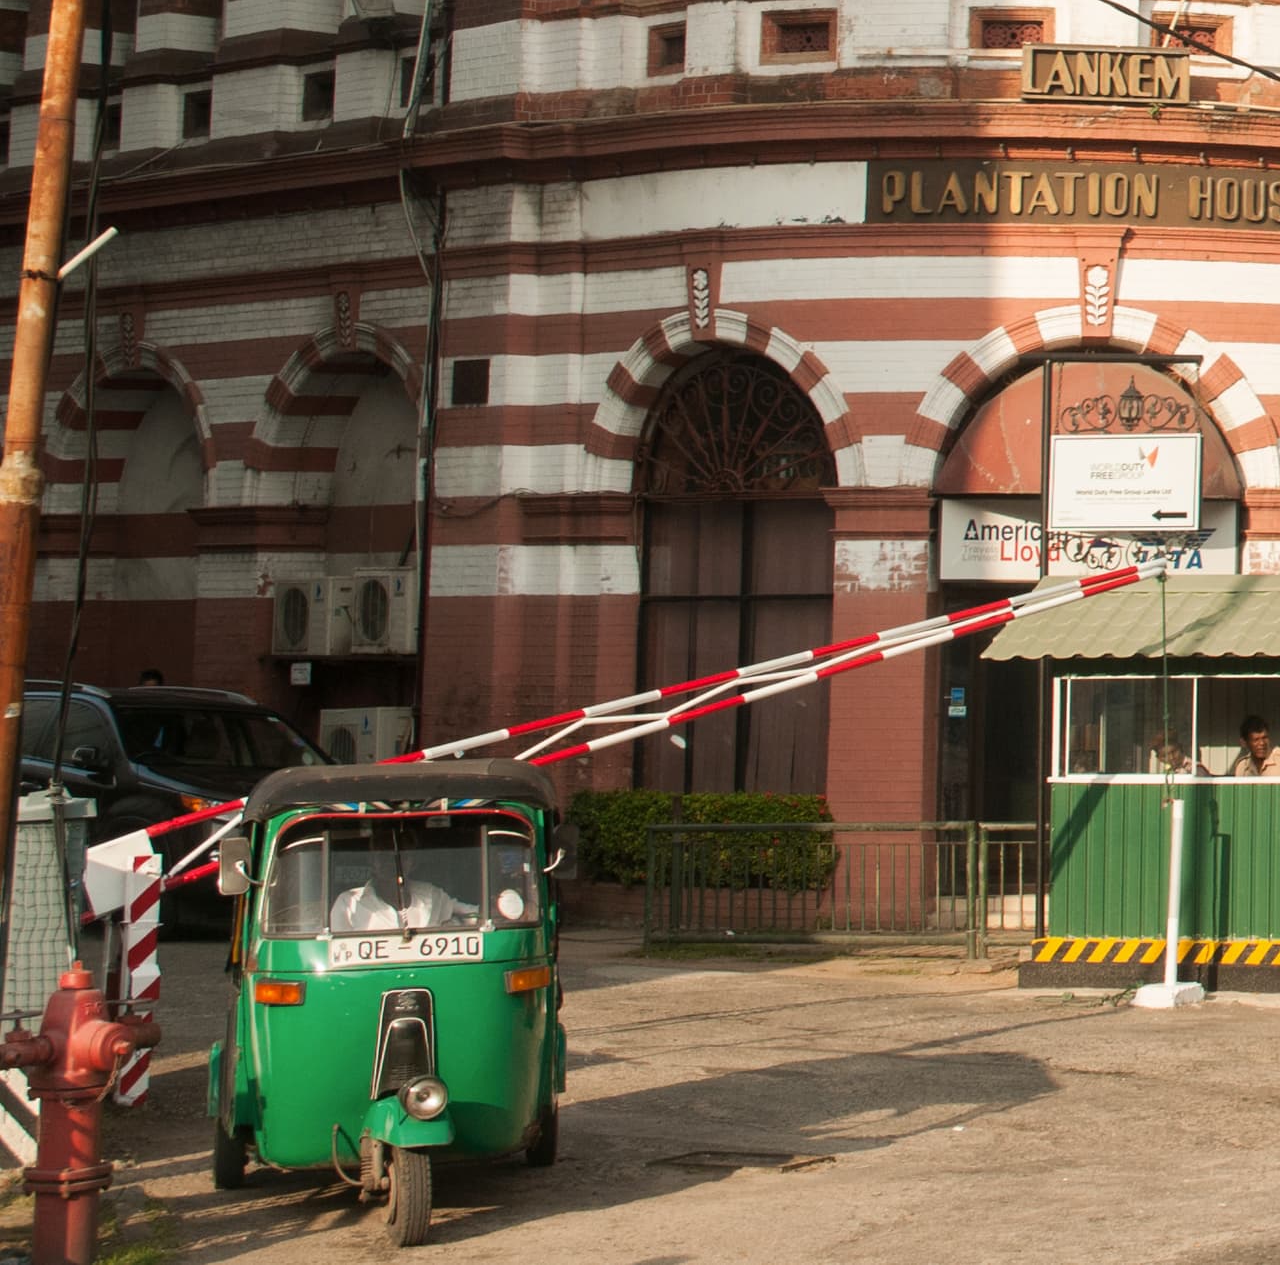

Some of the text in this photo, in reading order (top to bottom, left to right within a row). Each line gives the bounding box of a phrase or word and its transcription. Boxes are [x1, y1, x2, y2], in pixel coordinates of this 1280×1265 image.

[1022, 51, 1189, 102] LANKEM
[881, 170, 1160, 218] PLANTATION
[358, 940, 389, 959] QE
[420, 936, 480, 956] 6910
